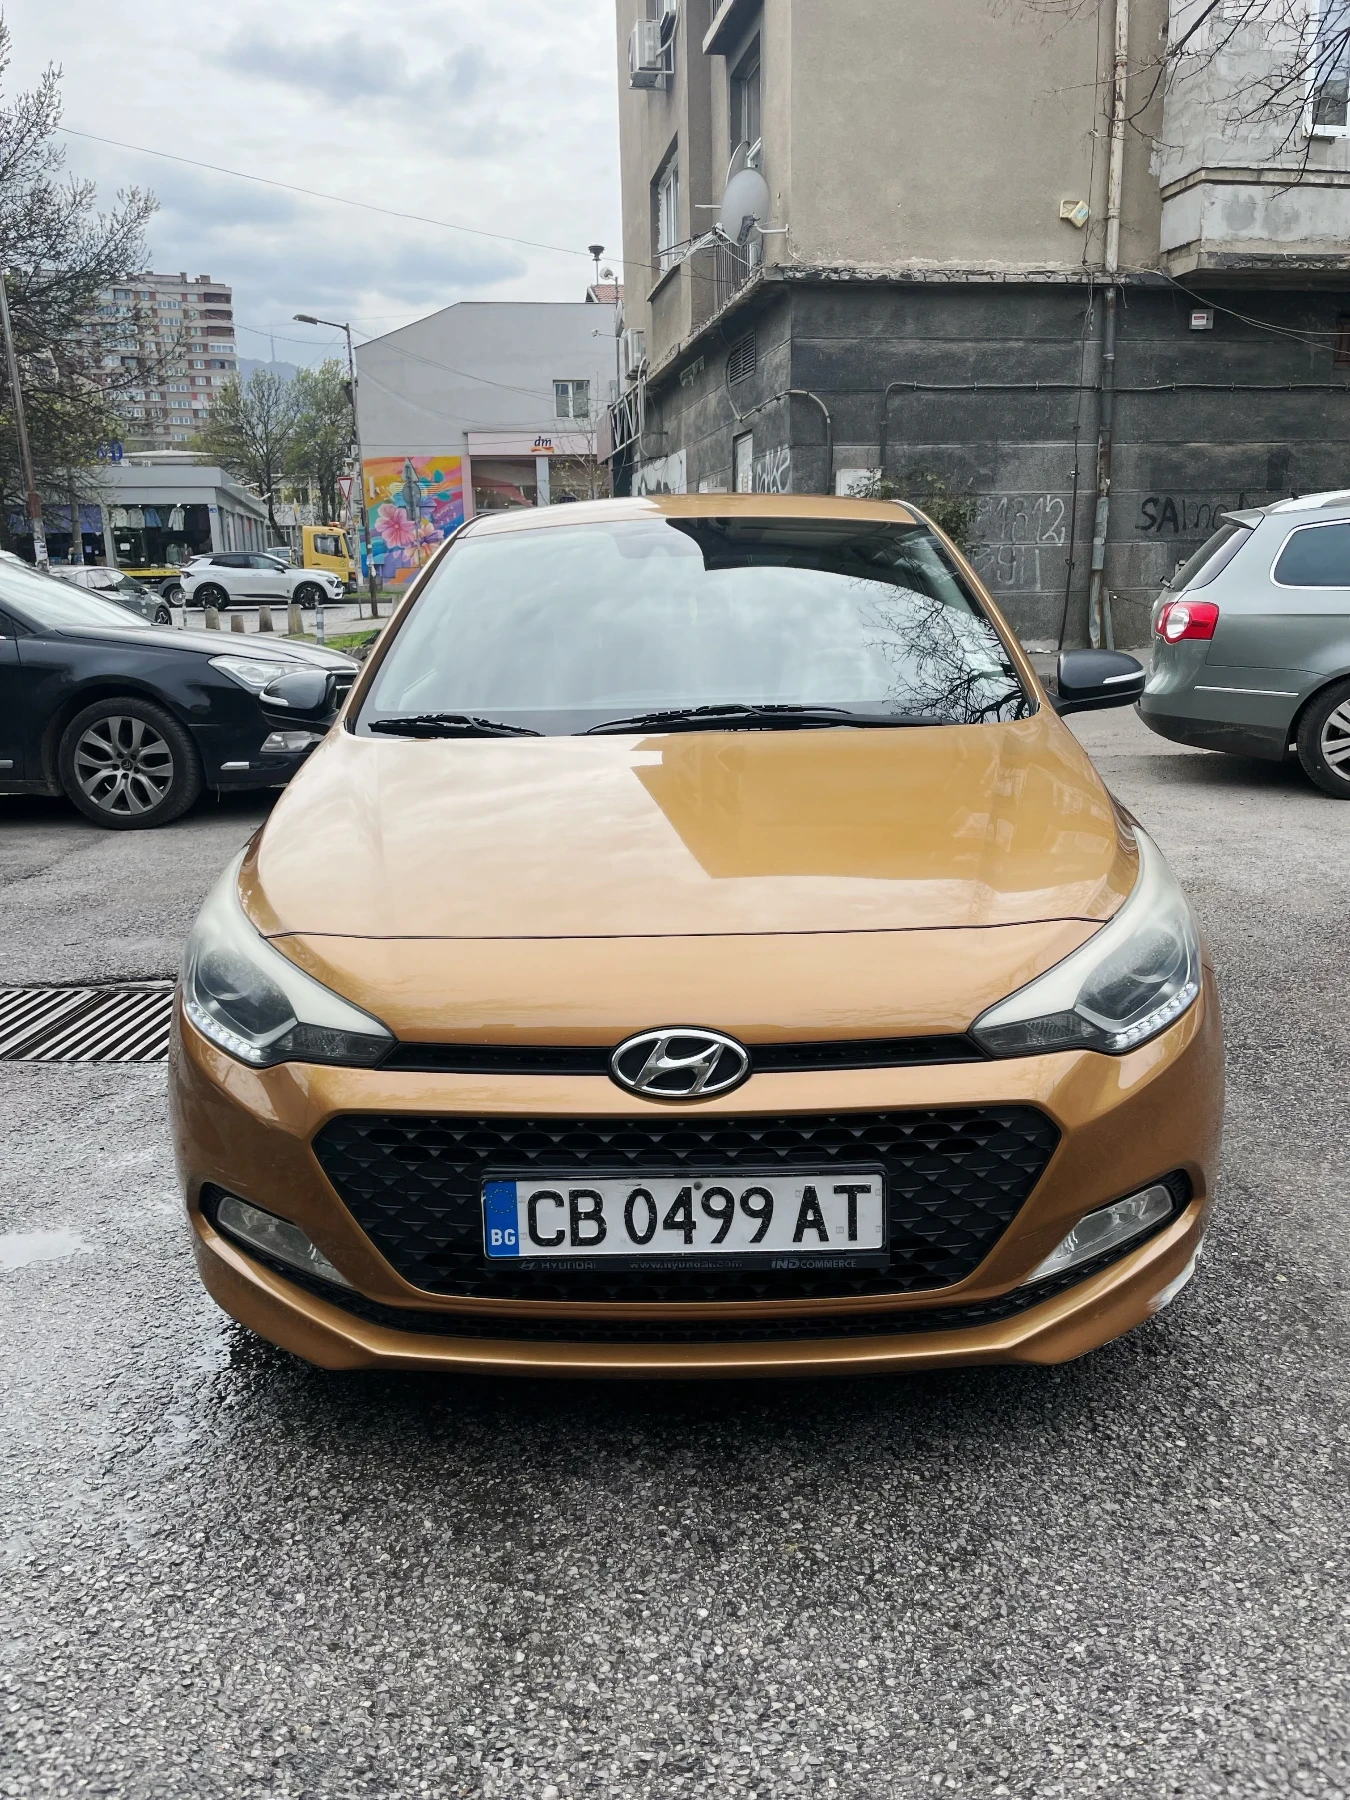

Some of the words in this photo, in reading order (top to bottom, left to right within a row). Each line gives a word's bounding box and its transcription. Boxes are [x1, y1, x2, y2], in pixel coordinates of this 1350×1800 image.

[534, 436, 552, 447] dm
[490, 1228, 516, 1246] BG
[527, 1188, 608, 1247] CB
[623, 1186, 774, 1245] 0499
[792, 1184, 872, 1242] AT
